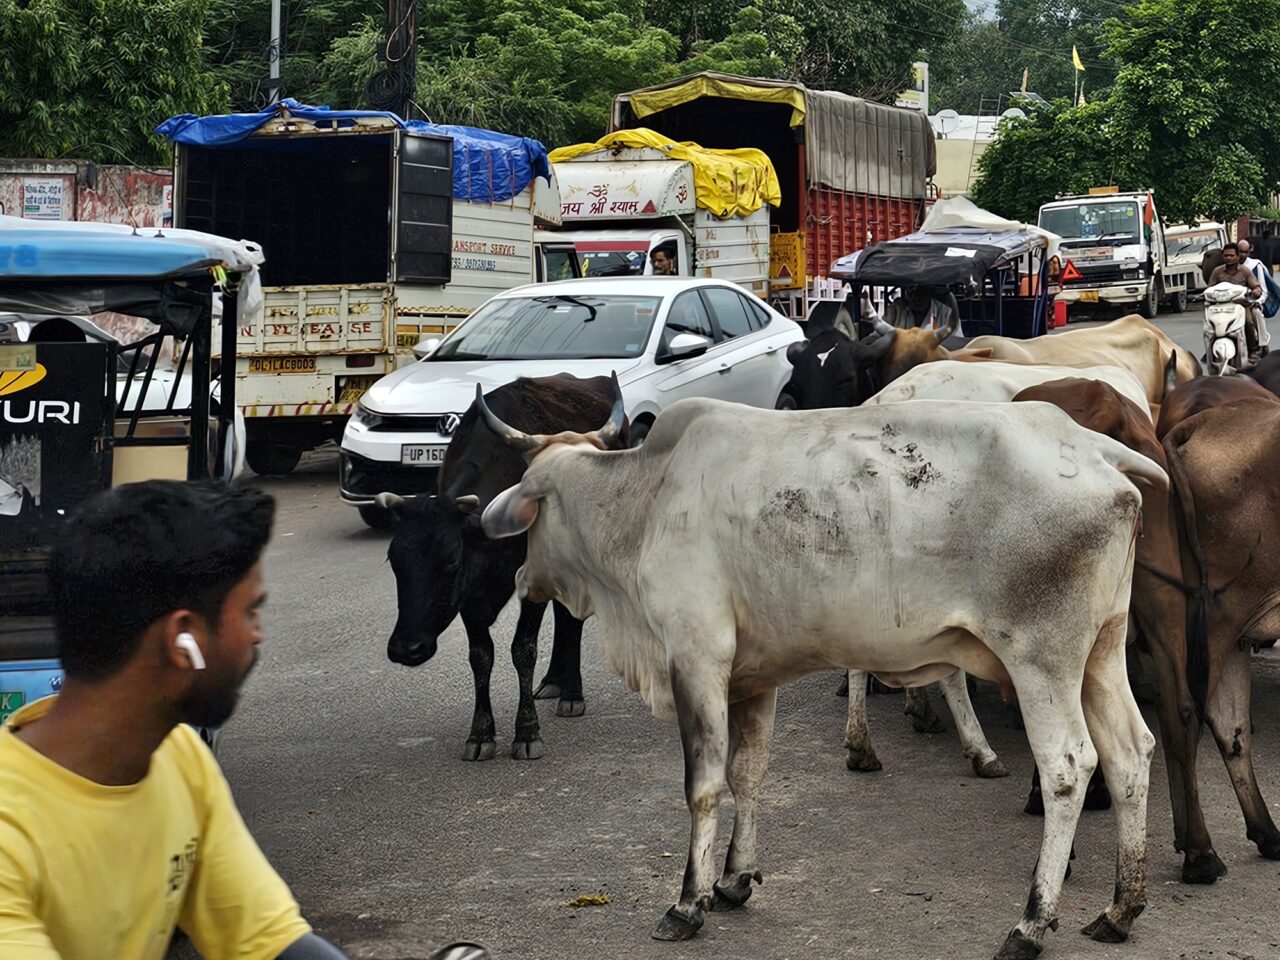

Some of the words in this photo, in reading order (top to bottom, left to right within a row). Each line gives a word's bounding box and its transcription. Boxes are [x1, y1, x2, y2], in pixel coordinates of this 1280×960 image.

[561, 203, 584, 215] जय
[589, 196, 608, 215] श्री
[0, 400, 81, 425] URI
